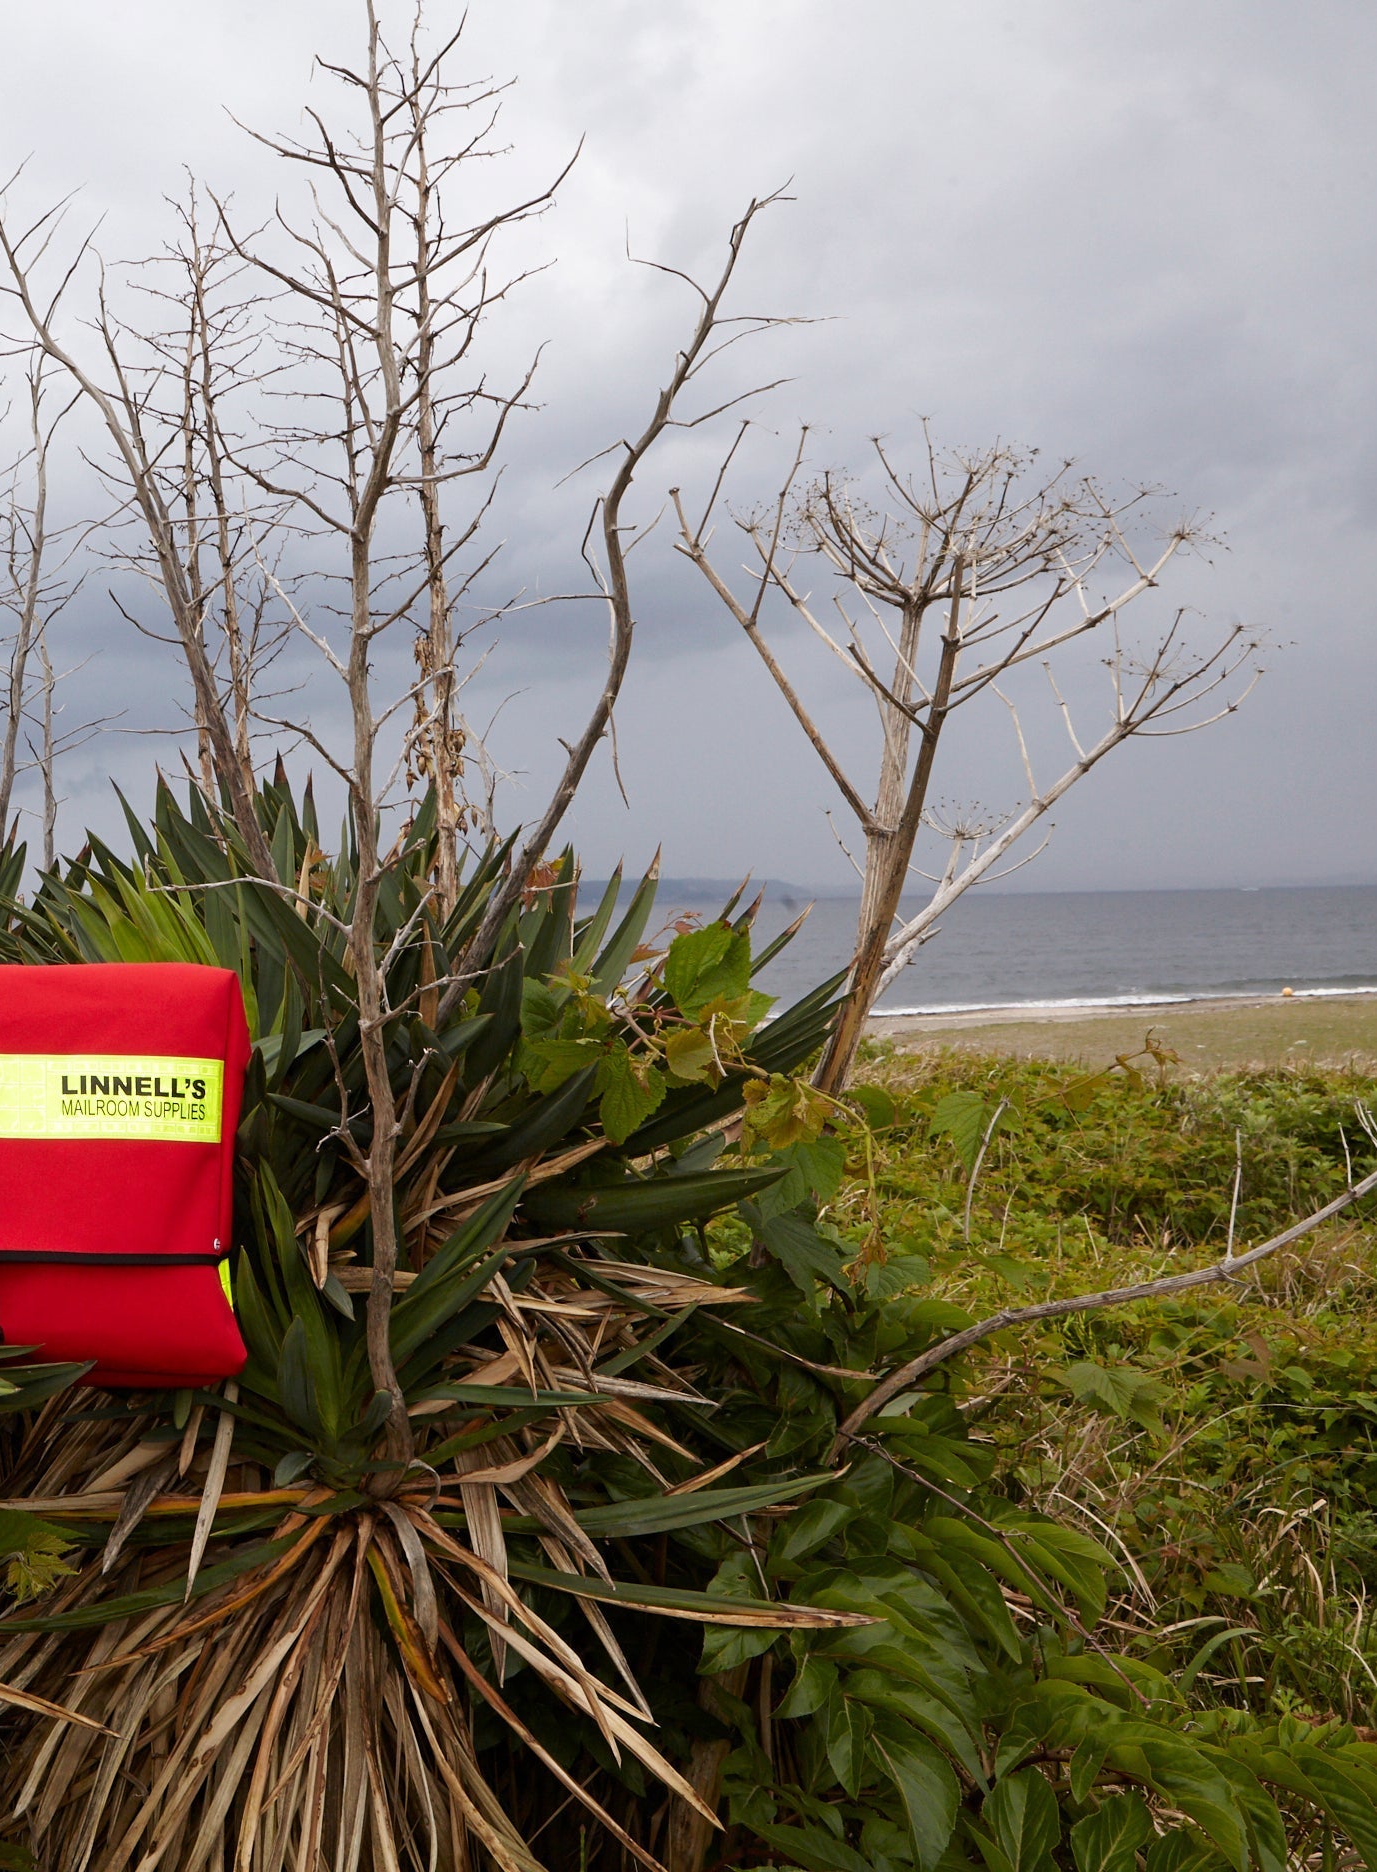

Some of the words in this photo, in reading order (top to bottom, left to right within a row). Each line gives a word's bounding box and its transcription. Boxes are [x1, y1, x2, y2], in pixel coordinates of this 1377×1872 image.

[61, 1075, 206, 1100] LINNELL'S
[61, 1099, 140, 1117] MAILROOM
[144, 1101, 206, 1121] SUPPLIES
